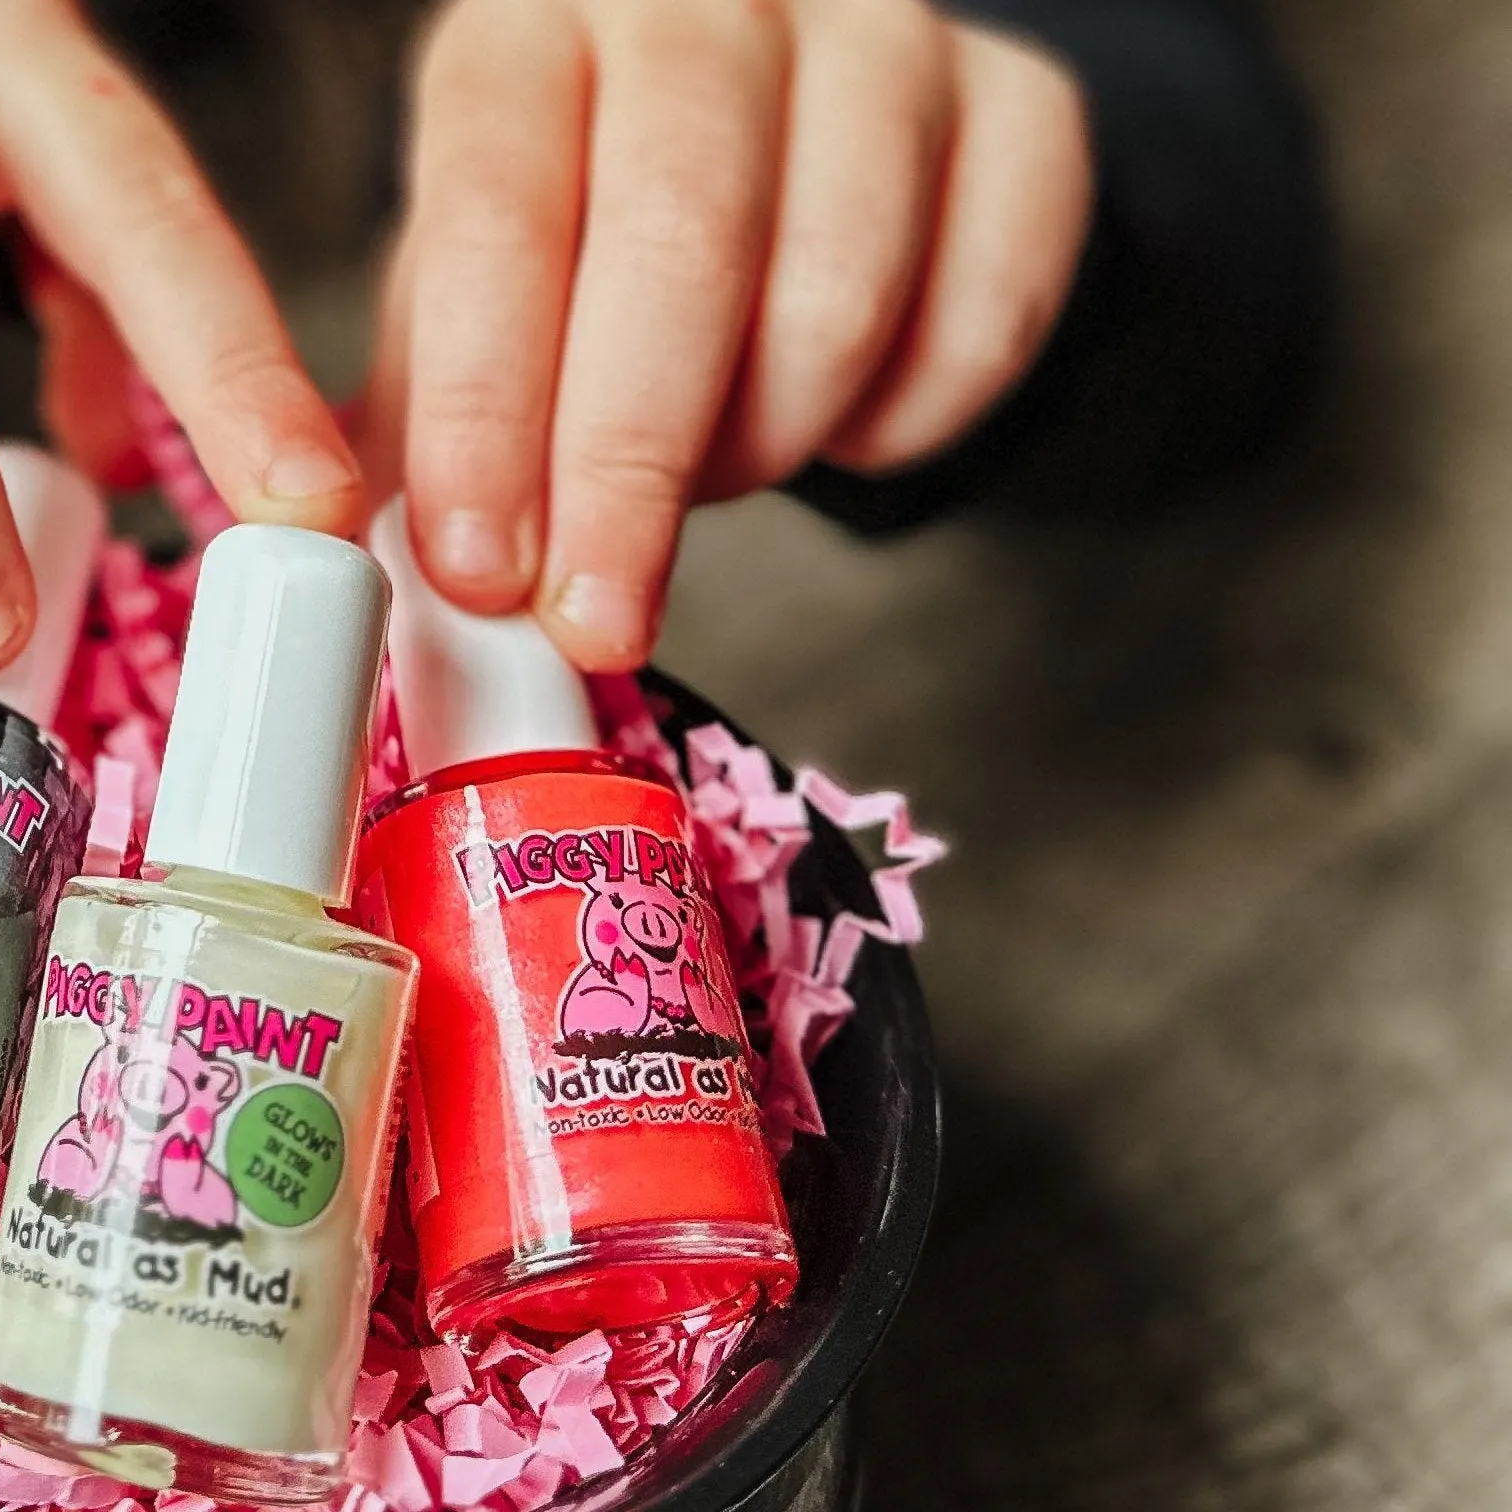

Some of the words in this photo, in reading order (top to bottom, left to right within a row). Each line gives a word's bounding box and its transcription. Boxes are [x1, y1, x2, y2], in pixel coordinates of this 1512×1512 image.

[456, 829, 625, 907] PIGGY
[43, 954, 161, 1034] PIGGY
[160, 978, 344, 1080] PAINT
[530, 1056, 682, 1105] Natural
[263, 1102, 336, 1162] GLOWS
[264, 1135, 285, 1157] IN
[536, 1104, 630, 1135] on-toxic
[646, 1102, 685, 1121] Low
[245, 1154, 306, 1210] DARK
[7, 1207, 114, 1270] Natural
[133, 1252, 180, 1284] as
[207, 1259, 302, 1310] Mud.
